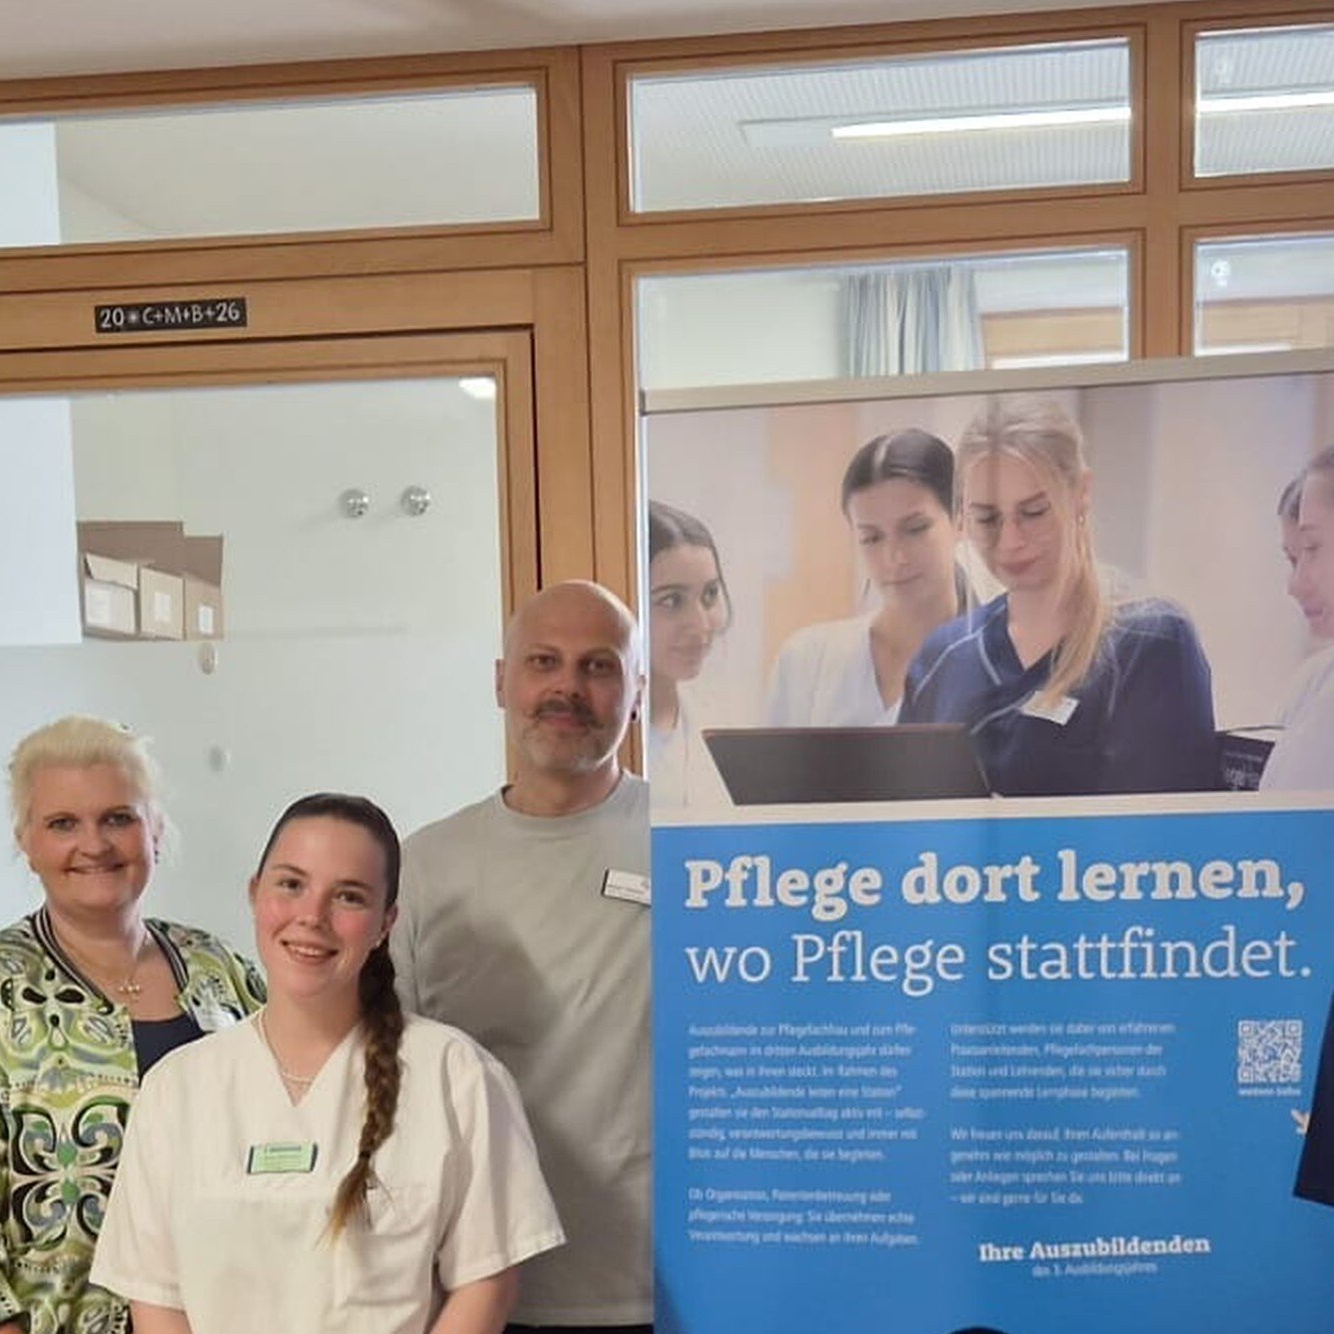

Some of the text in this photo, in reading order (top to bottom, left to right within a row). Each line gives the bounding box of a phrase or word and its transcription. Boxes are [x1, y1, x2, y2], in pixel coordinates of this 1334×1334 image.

[684, 849, 1305, 922] Pflege dort lernen,
[685, 925, 1312, 997] wo Pflege stattfindet.
[979, 1235, 1211, 1262] Ihre Auszubildenden
